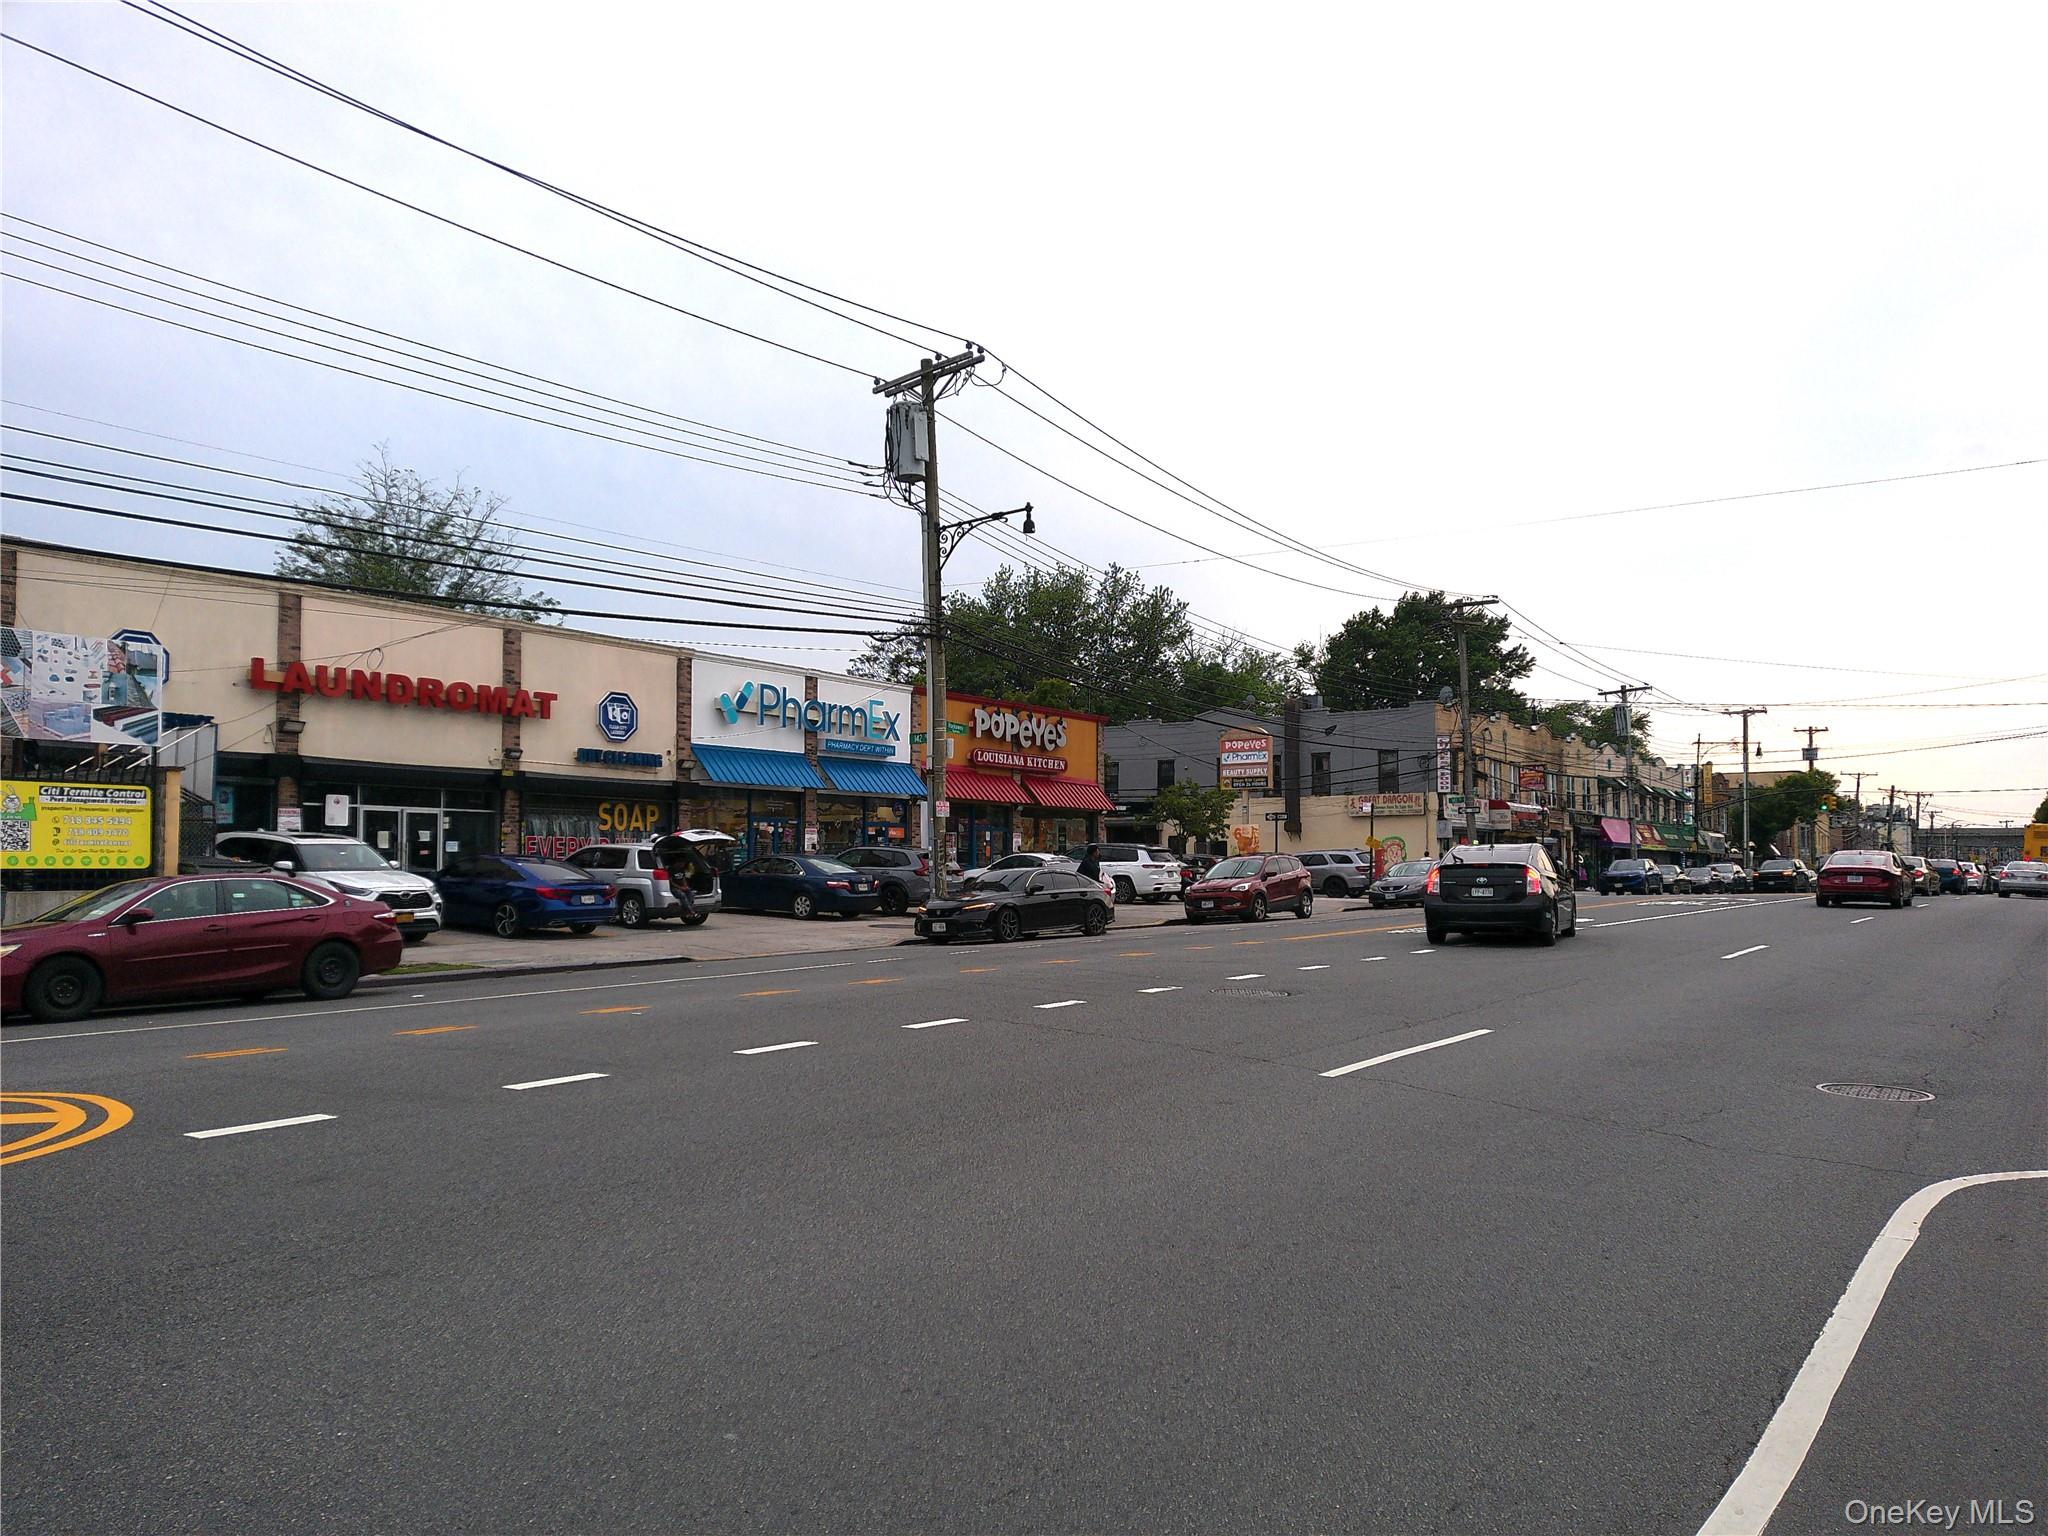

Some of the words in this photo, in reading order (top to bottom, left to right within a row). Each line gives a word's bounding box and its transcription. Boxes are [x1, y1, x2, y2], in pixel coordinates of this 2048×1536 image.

[250, 656, 558, 720] LAUNDROMAT
[758, 683, 901, 741] PharmEx
[827, 740, 859, 751] PHARMACY
[859, 743, 874, 752] DEPT
[875, 745, 895, 755] WITHIN
[977, 751, 1025, 766] LOUISIANA
[1027, 756, 1065, 770] KITCHEN
[1246, 767, 1267, 775] SUPPLY
[40, 786, 60, 796] Citi
[63, 788, 105, 797] Termite
[106, 789, 145, 798] Control
[1358, 795, 1380, 804] GREAT
[1383, 794, 1413, 804] DRAGON
[64, 815, 82, 824] 718
[598, 802, 660, 832] SOAP
[525, 835, 593, 861] EVERY
